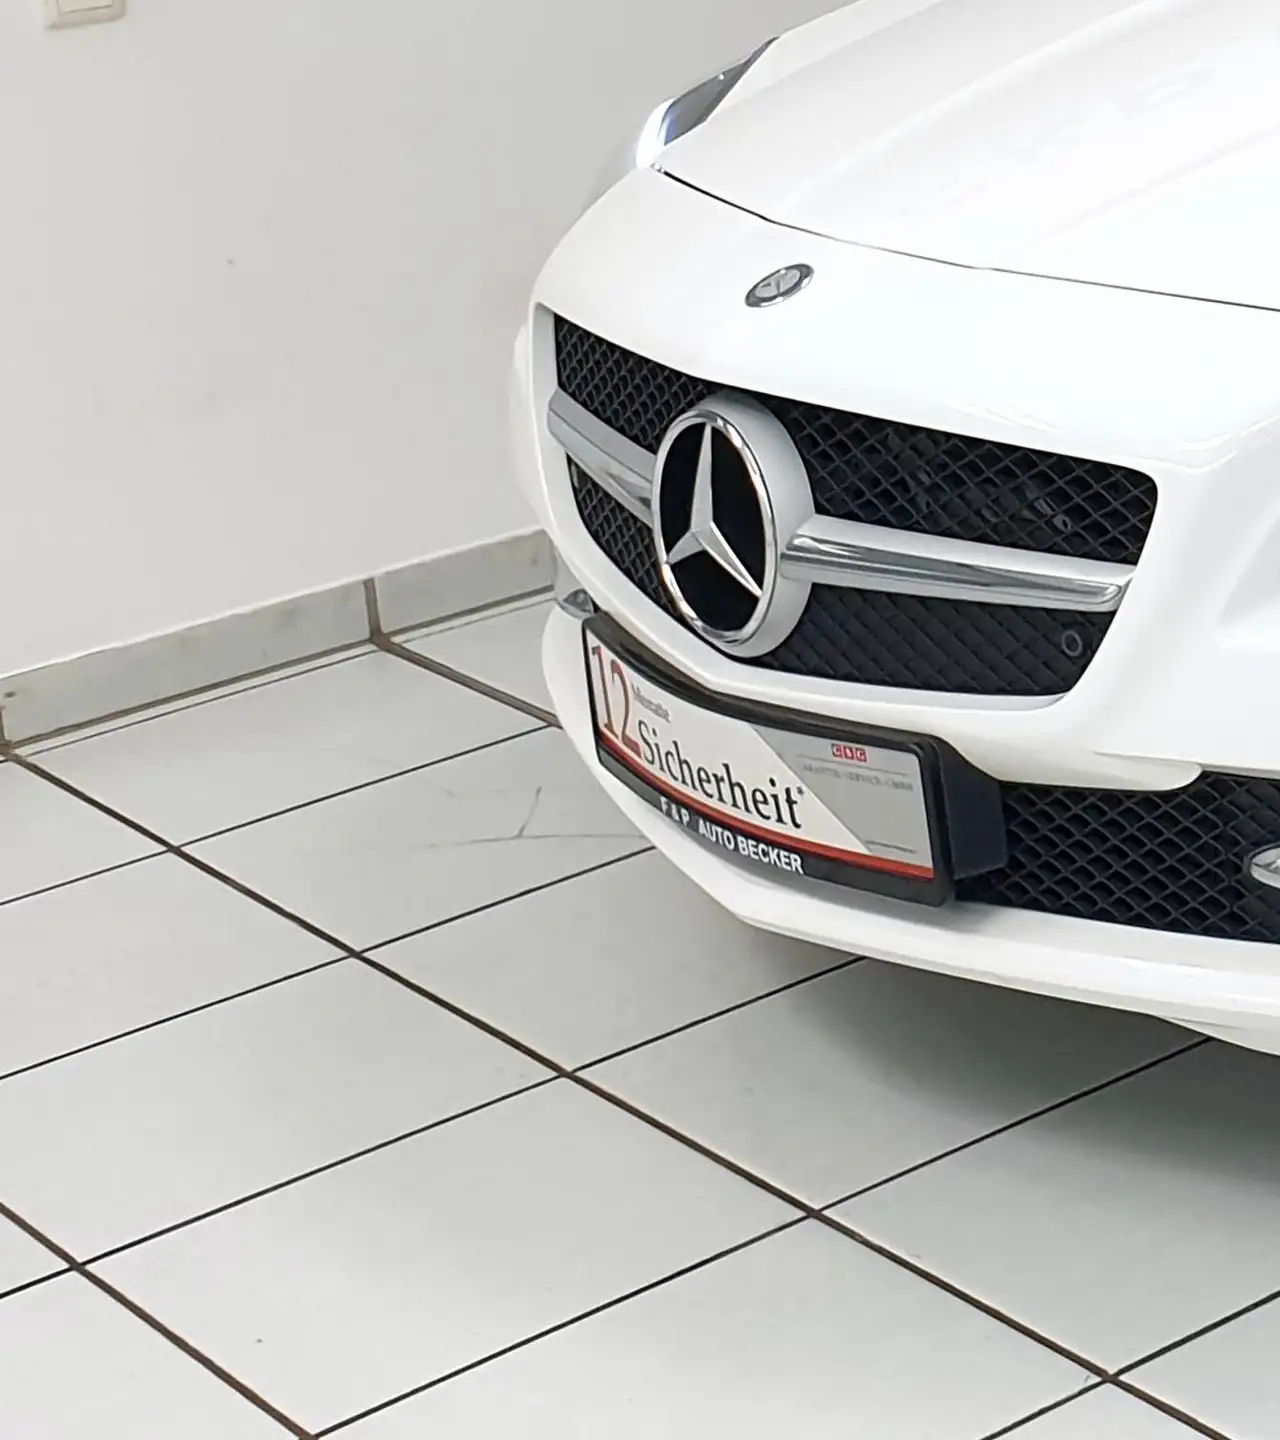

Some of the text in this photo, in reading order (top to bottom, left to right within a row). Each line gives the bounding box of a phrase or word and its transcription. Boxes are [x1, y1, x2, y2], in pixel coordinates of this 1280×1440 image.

[591, 645, 643, 760] 12
[638, 719, 802, 830] Sicherheit
[699, 816, 735, 851] AUTO
[737, 834, 804, 874] BECKER
